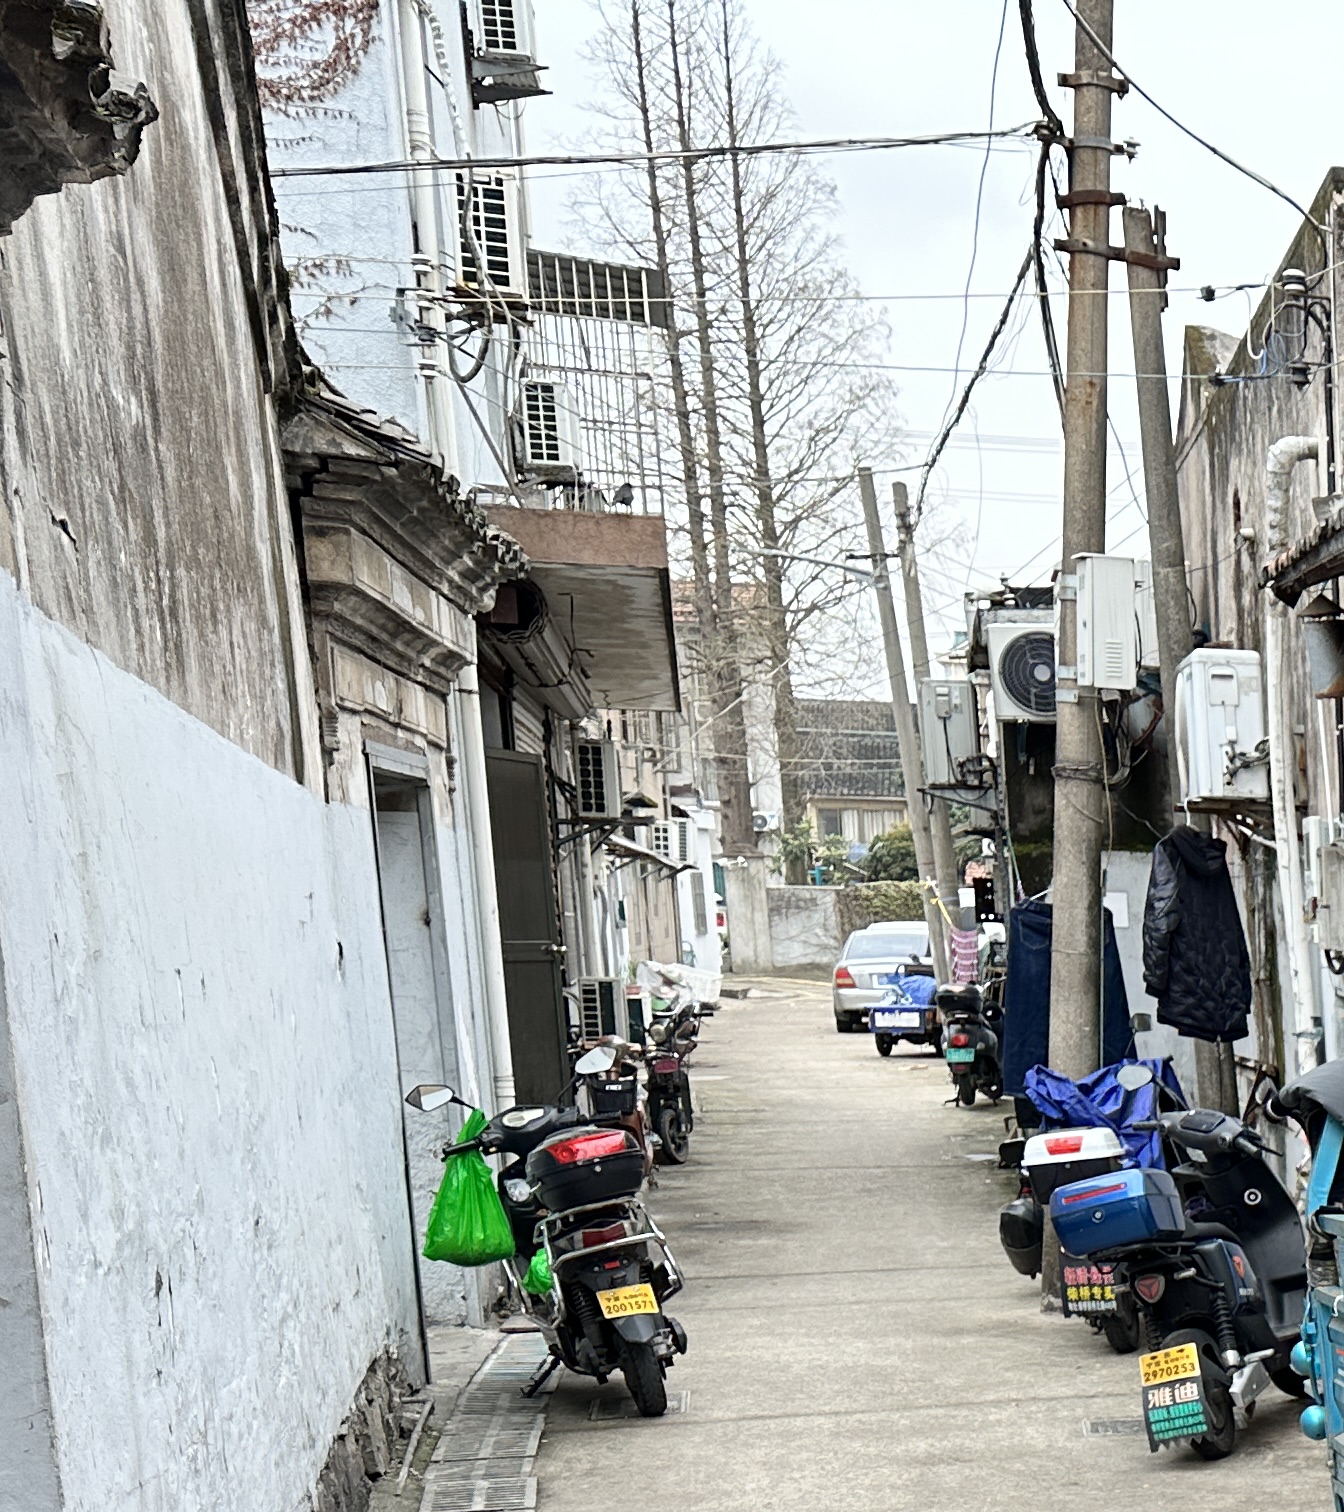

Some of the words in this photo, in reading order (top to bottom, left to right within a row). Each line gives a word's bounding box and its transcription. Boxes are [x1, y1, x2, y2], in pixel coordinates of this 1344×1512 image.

[605, 1300, 656, 1315] 2001571
[1144, 1362, 1197, 1383] 2970253
[1147, 1381, 1200, 1409] 雅迪
